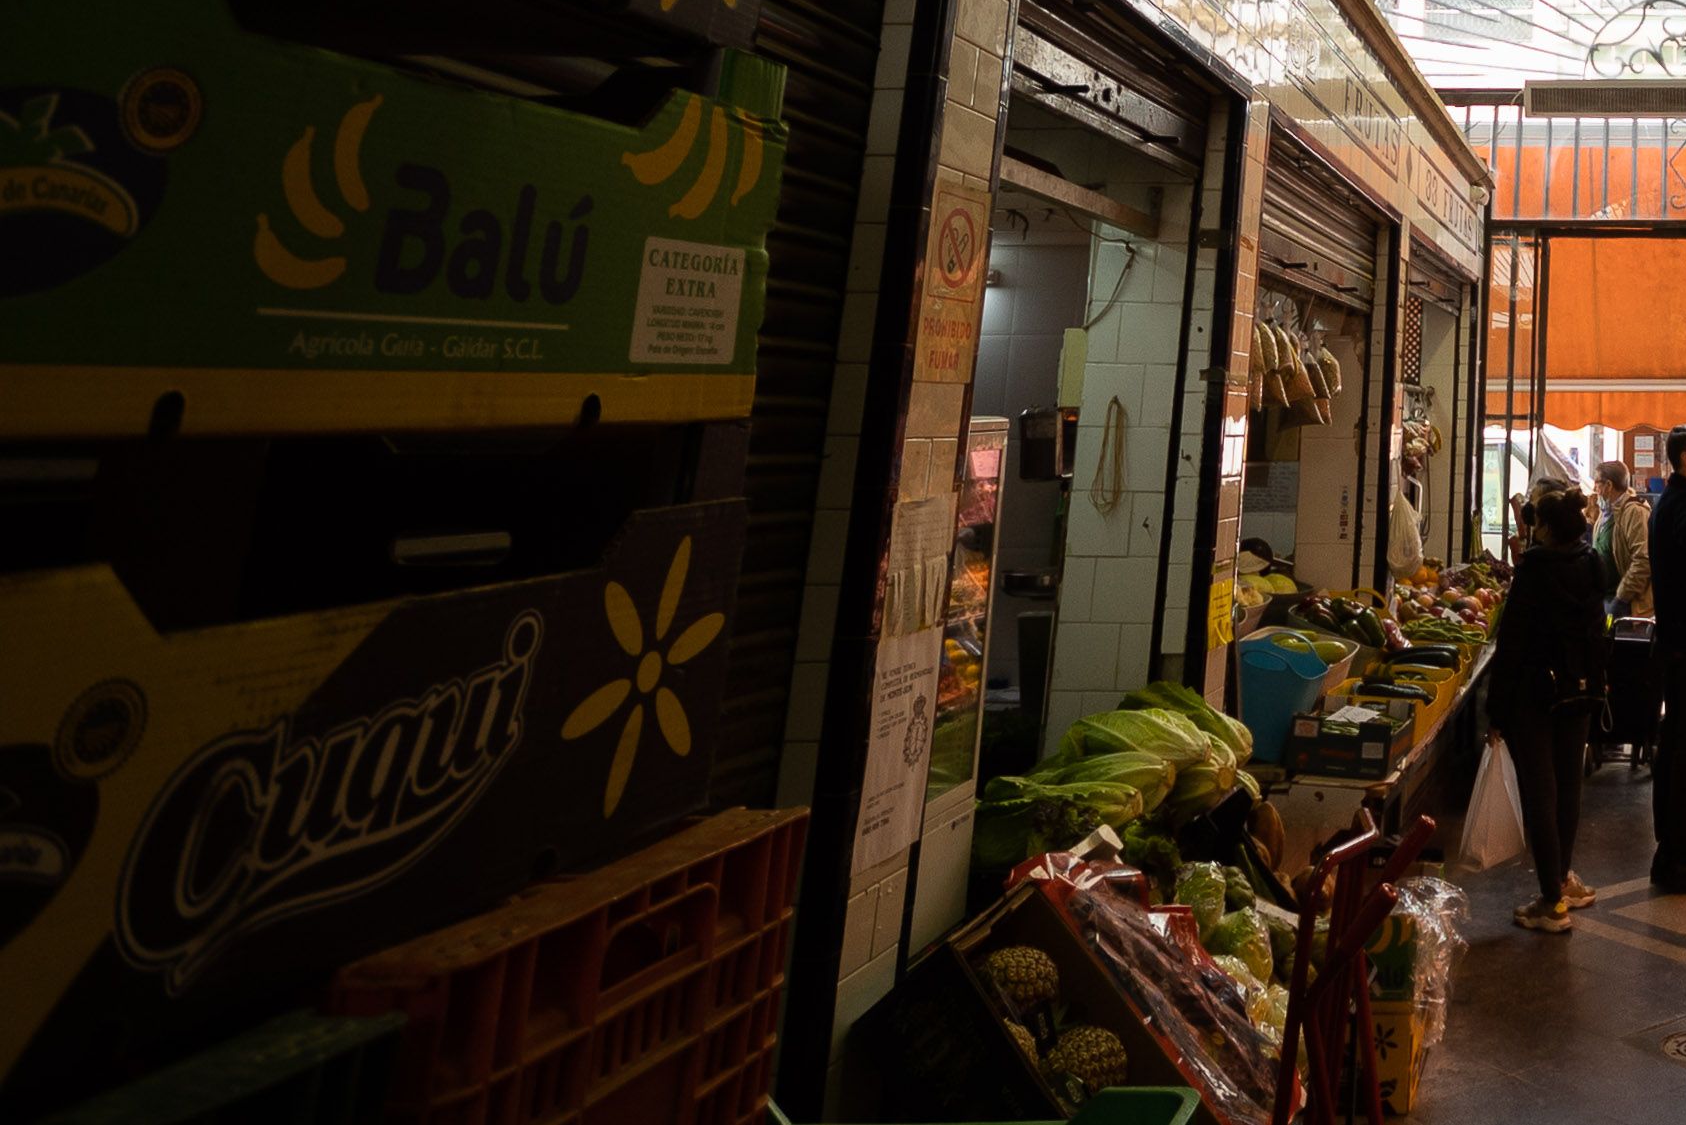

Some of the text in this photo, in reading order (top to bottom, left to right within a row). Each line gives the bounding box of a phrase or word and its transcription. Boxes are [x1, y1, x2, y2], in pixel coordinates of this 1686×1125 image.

[1343, 76, 1400, 169] FRUTAS
[1424, 172, 1476, 241] 33 FRUTAS
[375, 162, 592, 306] Balú
[648, 248, 739, 276] CATEGORÍA
[665, 277, 716, 298] EXTRA
[922, 319, 973, 341] PROHIBIDO
[928, 350, 960, 370] FUMAR
[115, 608, 546, 986] Cuqui
